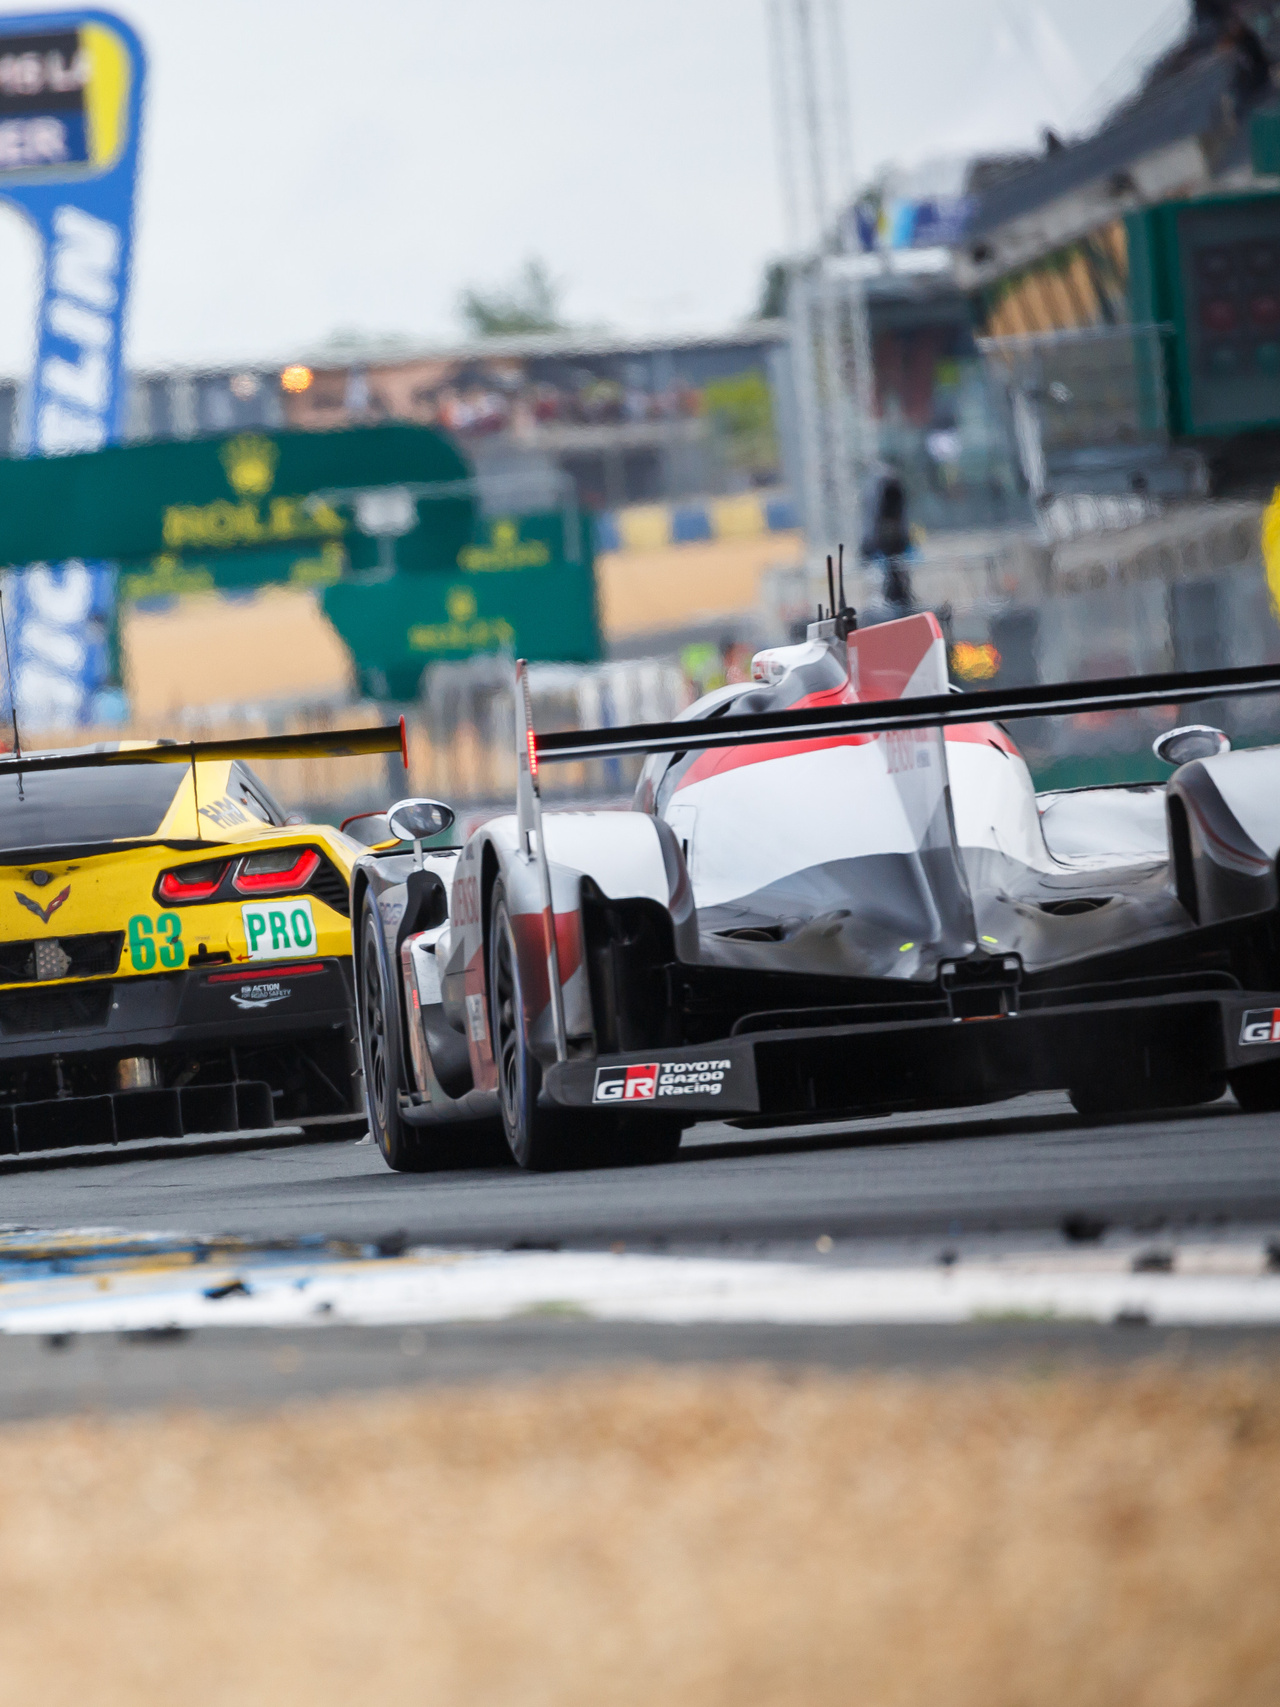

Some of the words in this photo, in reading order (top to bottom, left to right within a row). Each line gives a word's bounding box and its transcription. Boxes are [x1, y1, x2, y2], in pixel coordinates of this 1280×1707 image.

[161, 498, 347, 548] ROLEX
[246, 908, 312, 951] PRO
[128, 912, 185, 971] 63
[253, 983, 280, 992] ACTION
[268, 988, 292, 997] SAFETY
[1244, 1022, 1280, 1041] G
[661, 1059, 732, 1074] TOYOTA
[659, 1070, 725, 1085] GAZOO
[596, 1077, 655, 1100] GR
[658, 1082, 722, 1096] Racing
